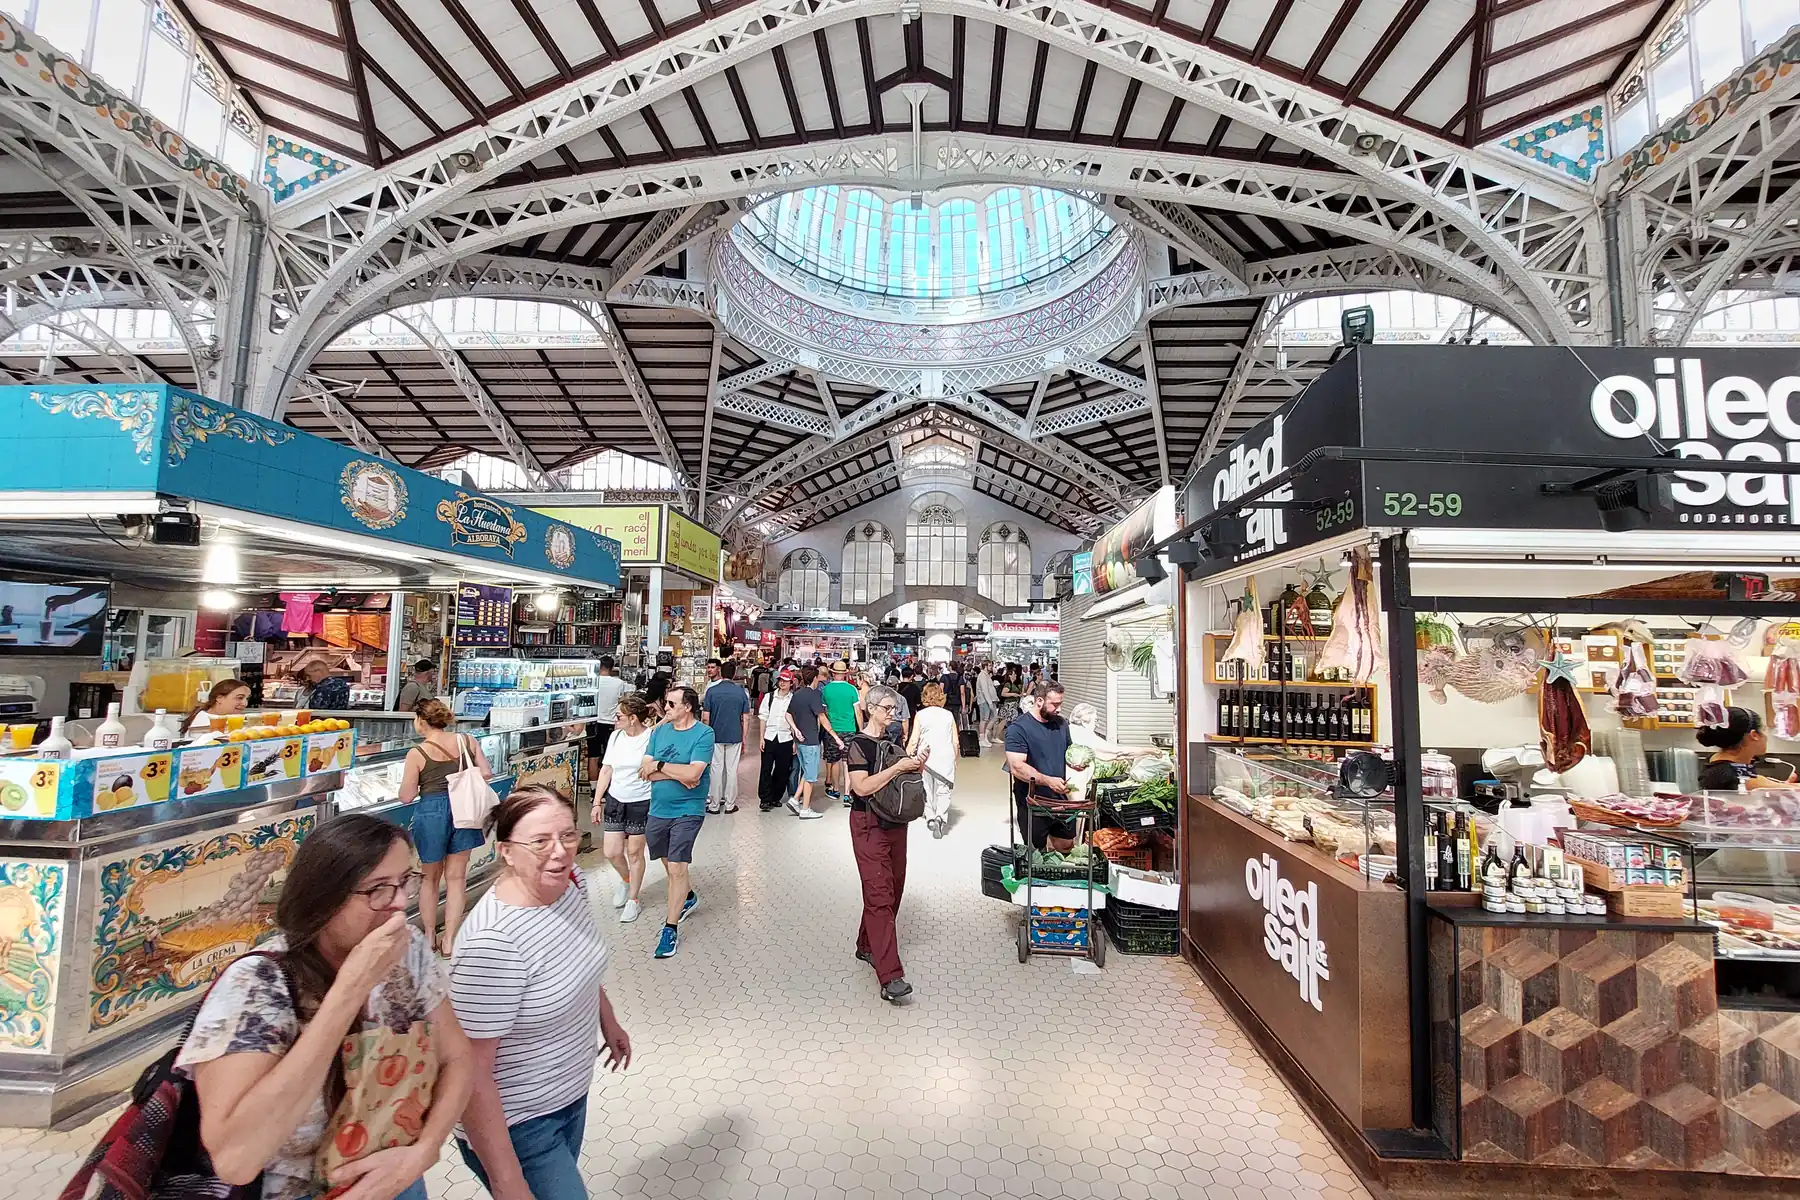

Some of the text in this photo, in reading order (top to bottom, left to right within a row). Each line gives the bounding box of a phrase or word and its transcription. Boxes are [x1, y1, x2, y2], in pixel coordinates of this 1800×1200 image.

[1384, 493, 1462, 517] 52-59
[455, 503, 511, 535] La Huertana
[638, 513, 647, 521] el
[1316, 499, 1354, 531] 52-59
[624, 523, 647, 533] racó
[466, 534, 501, 543] ALBORAYA
[633, 535, 647, 545] de
[284, 745, 293, 758] 3
[337, 738, 345, 750] 3
[221, 752, 232, 767] 3
[146, 761, 158, 778] 3
[36, 770, 46, 788] 3
[1245, 852, 1319, 941] oiled
[192, 944, 237, 971] LA CREMA
[1264, 912, 1330, 1013] salt
